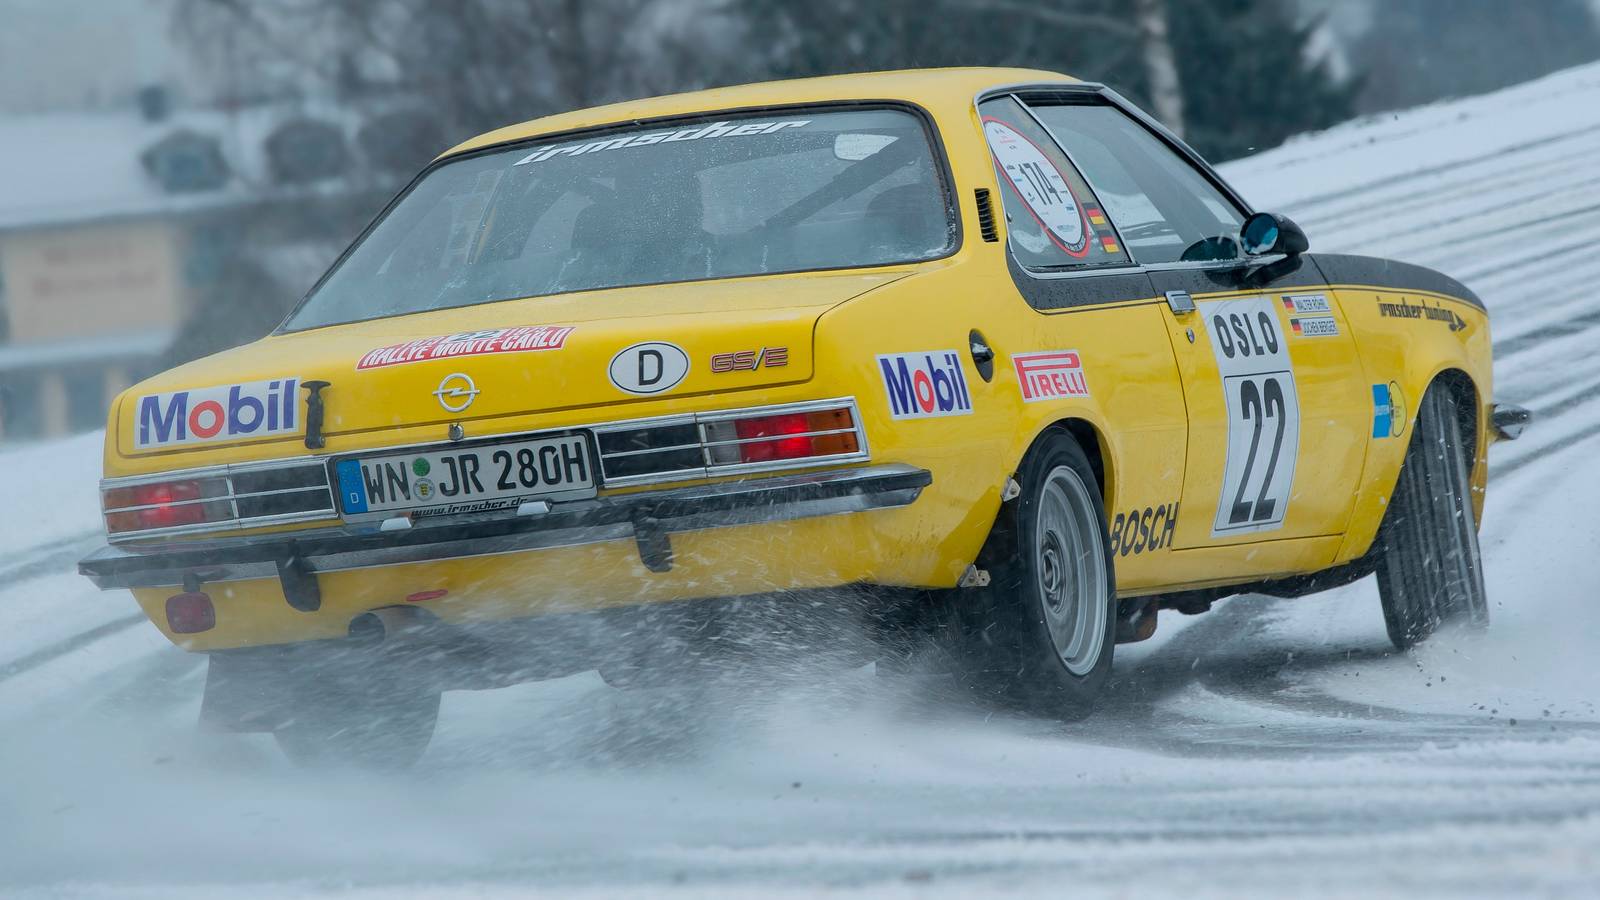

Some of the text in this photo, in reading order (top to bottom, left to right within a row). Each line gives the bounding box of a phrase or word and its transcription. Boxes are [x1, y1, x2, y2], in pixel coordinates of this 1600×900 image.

[513, 120, 812, 167] irmscher
[1018, 162, 1063, 206] 174
[362, 345, 433, 366] RALLYE
[1213, 311, 1279, 359] OSLO
[638, 349, 663, 386] D
[711, 347, 788, 374] GS/E
[1013, 353, 1089, 399] PIRELLI
[880, 353, 971, 416] Mobil
[139, 379, 296, 445] Mobil
[361, 441, 587, 504] WN JR 280H
[1228, 377, 1286, 525] 22
[1110, 502, 1179, 557] BOSCH
